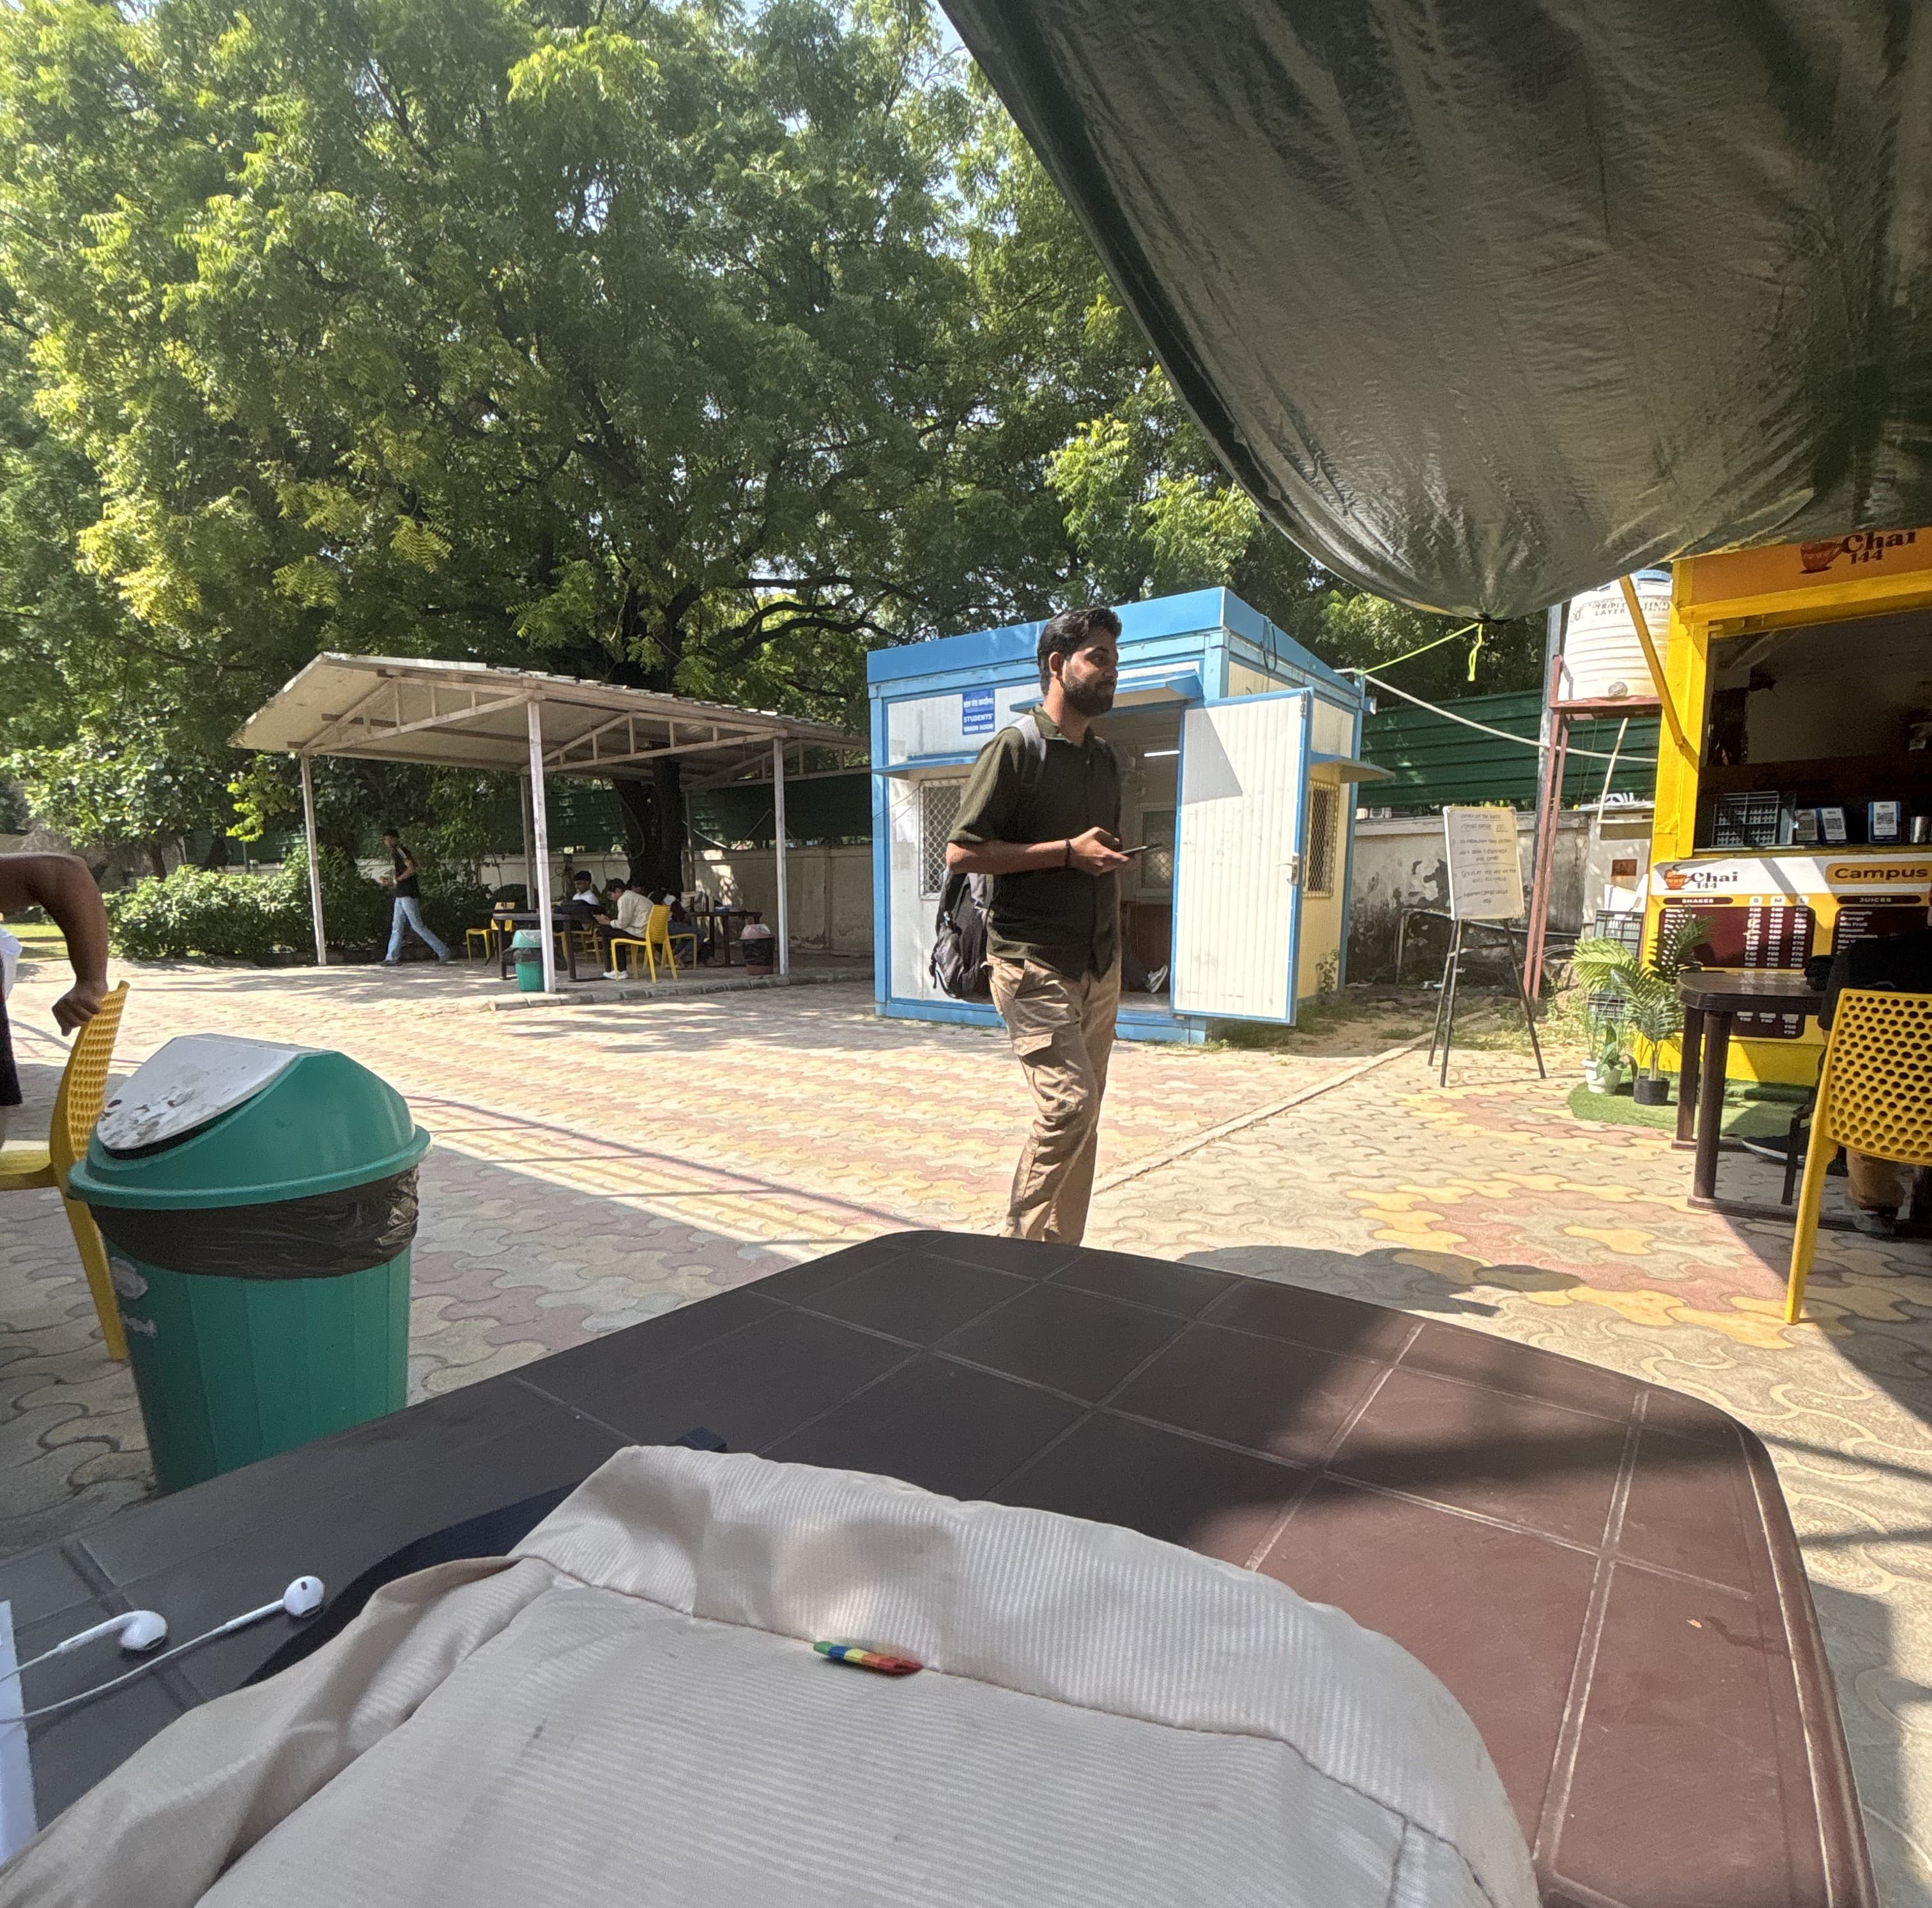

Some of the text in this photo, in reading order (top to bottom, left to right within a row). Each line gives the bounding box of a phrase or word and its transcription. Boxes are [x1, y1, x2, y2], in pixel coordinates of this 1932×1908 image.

[1841, 532, 1915, 553] Chai
[1850, 550, 1883, 564] 144
[963, 725, 979, 733] UNION
[1690, 872, 1738, 882] Chai
[1834, 868, 1928, 881] Campus
